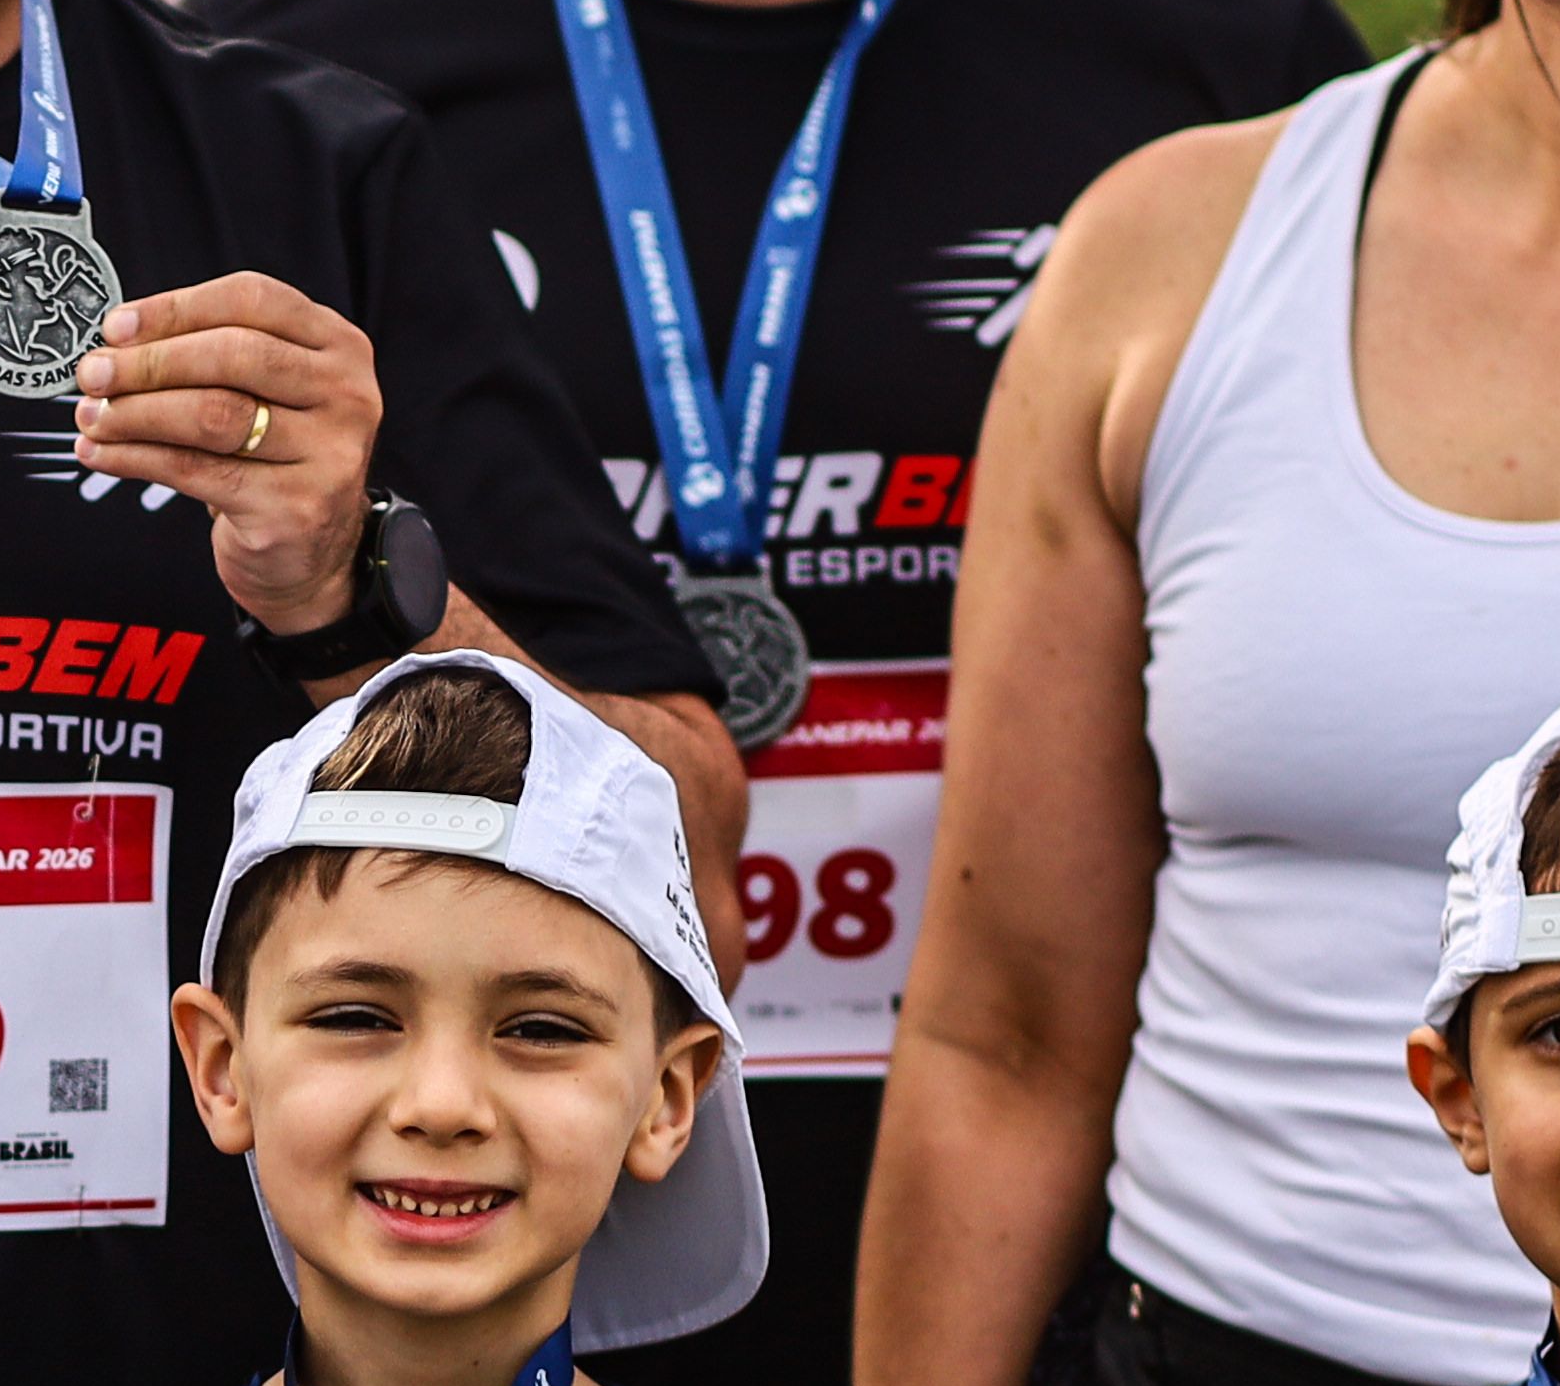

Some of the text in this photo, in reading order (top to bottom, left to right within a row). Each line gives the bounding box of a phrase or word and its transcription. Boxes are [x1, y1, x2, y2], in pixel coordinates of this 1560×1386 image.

[34, 845, 95, 871] 2026
[741, 848, 895, 963] 98
[0, 1140, 74, 1161] BRASIL
